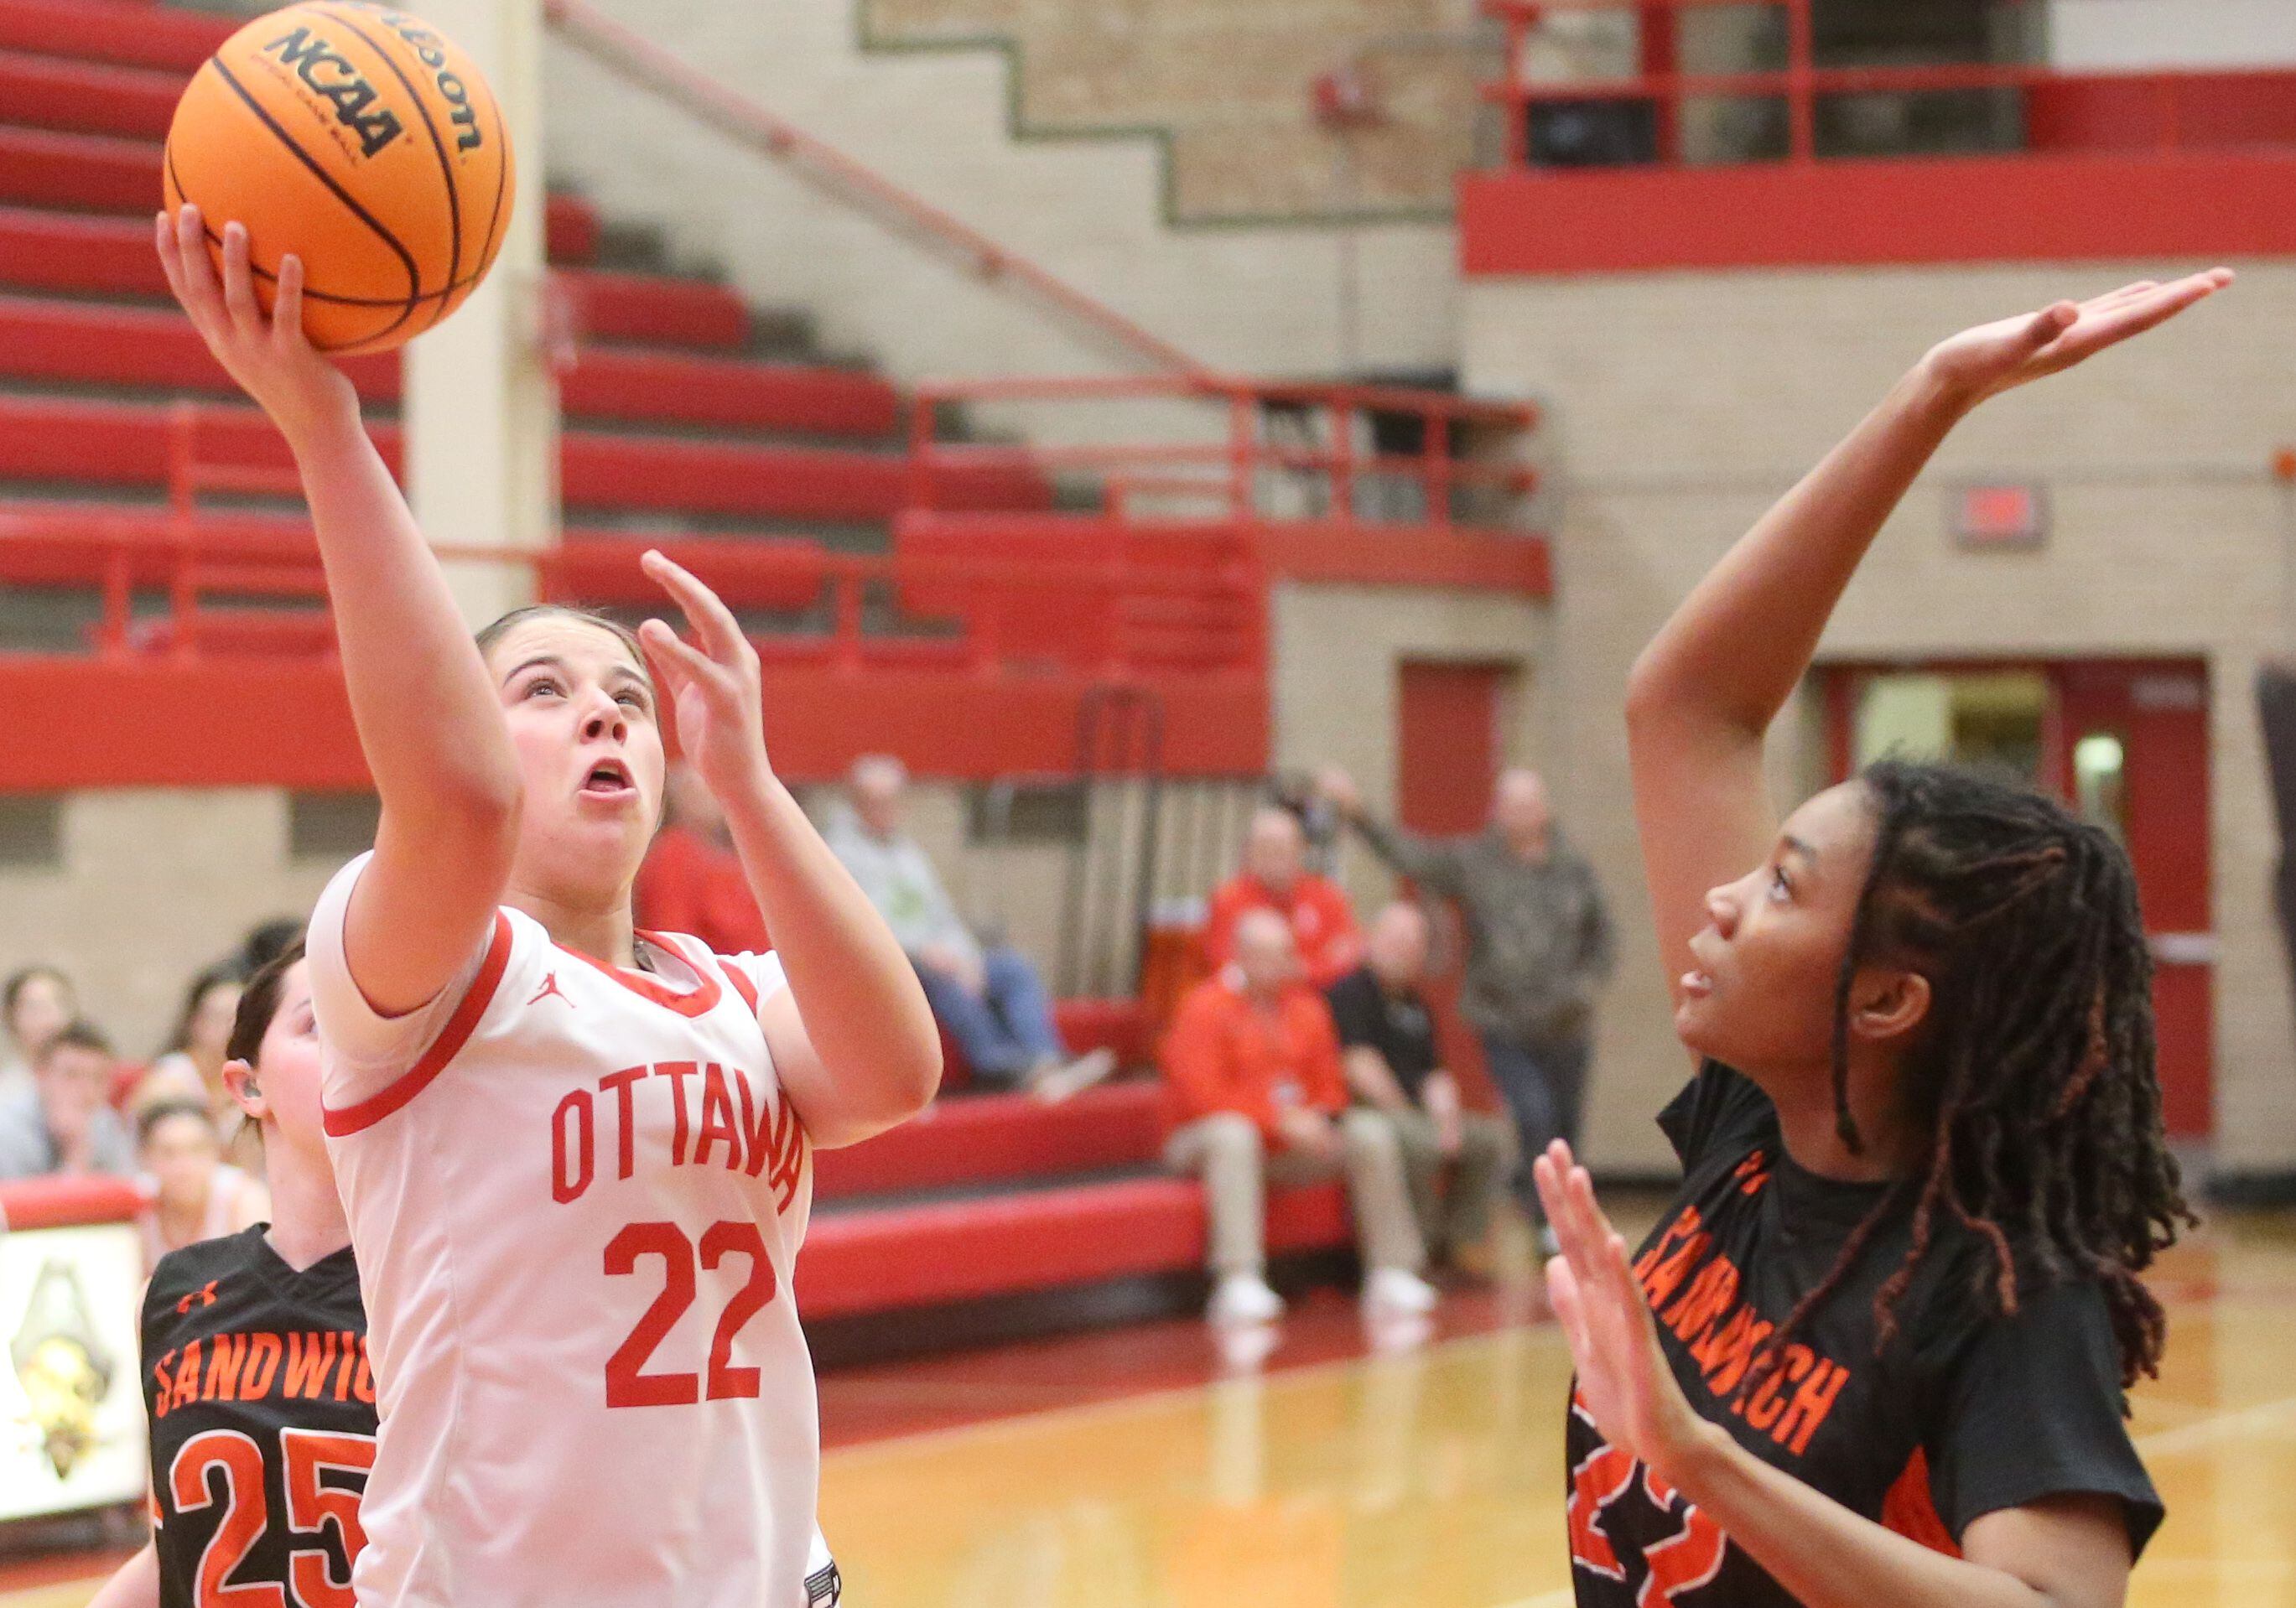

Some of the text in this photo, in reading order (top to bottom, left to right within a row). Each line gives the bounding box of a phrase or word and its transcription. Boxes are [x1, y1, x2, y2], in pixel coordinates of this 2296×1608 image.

[264, 27, 403, 158] NCAA
[551, 1061, 806, 1216] OTTAWA
[603, 1220, 777, 1408] 22
[169, 1427, 377, 1608] 25
